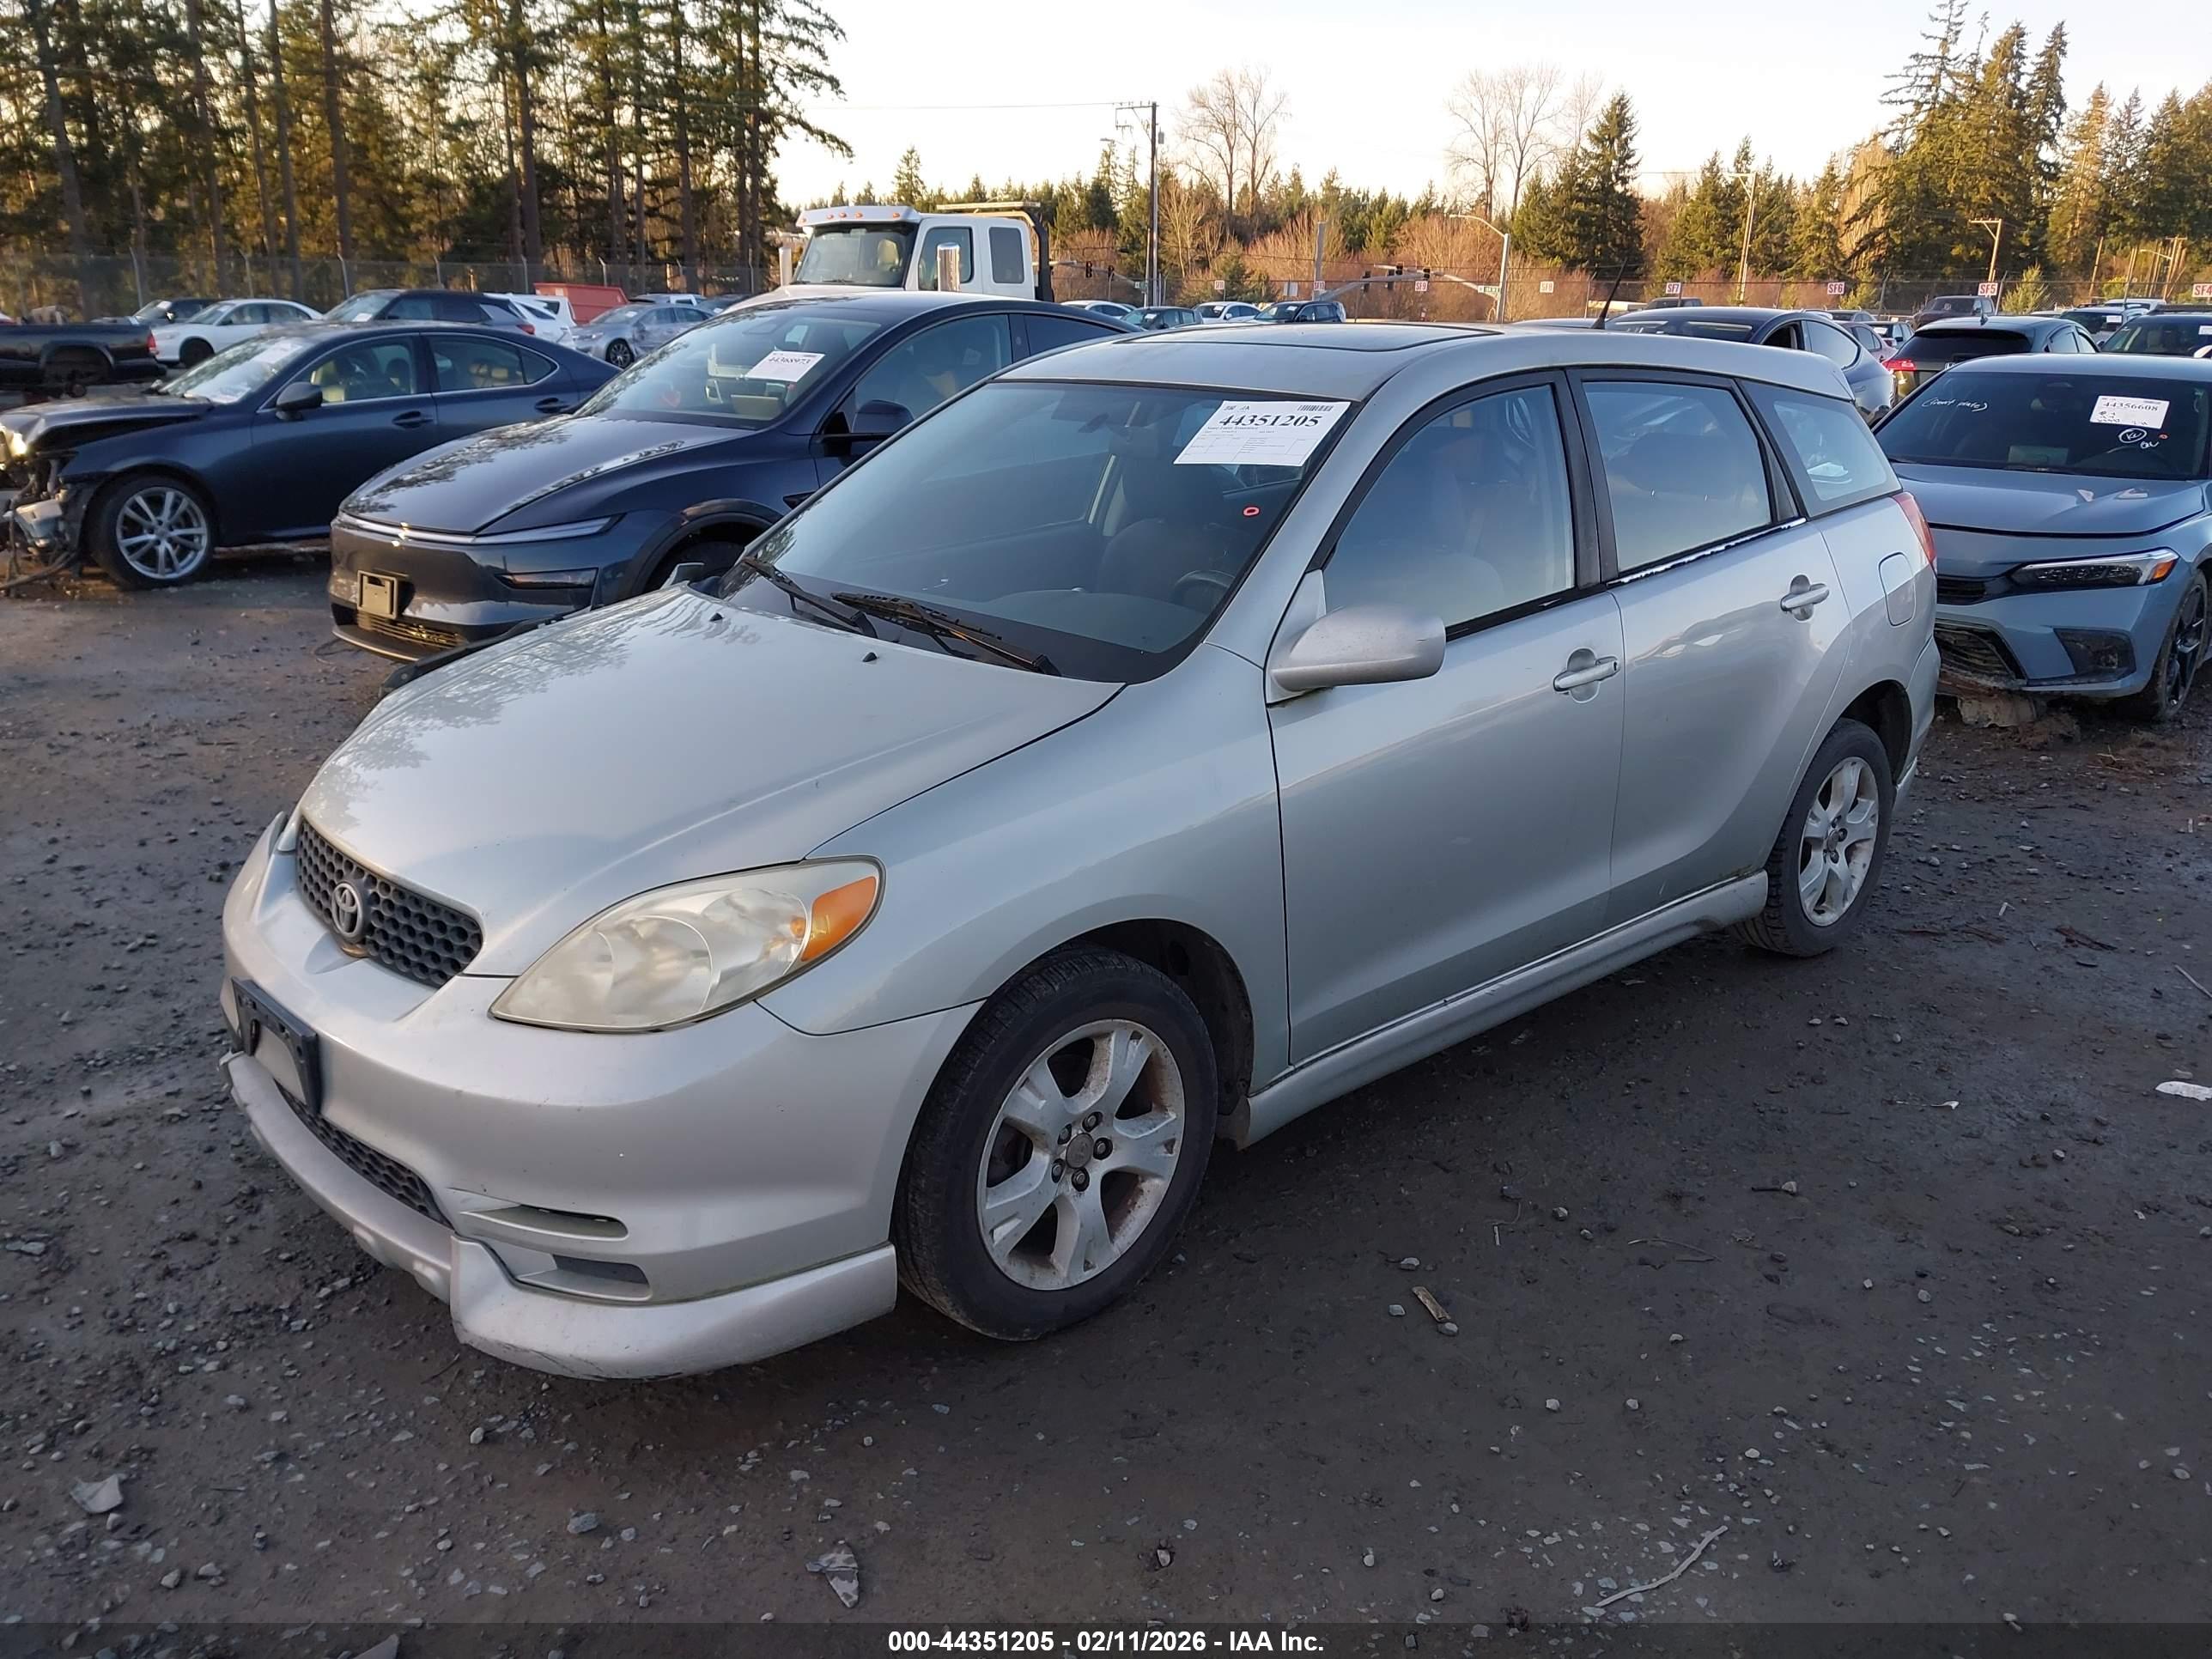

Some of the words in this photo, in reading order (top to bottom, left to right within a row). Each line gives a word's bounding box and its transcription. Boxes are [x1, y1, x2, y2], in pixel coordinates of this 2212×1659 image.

[1416, 282, 1426, 290] SF9
[1667, 283, 1680, 293] SF7
[1828, 283, 1844, 294] SF6
[1980, 284, 1996, 295] SF5
[2193, 285, 2212, 295] SF4
[2103, 402, 2158, 411] 44356608
[1218, 415, 1324, 428] 44351205
